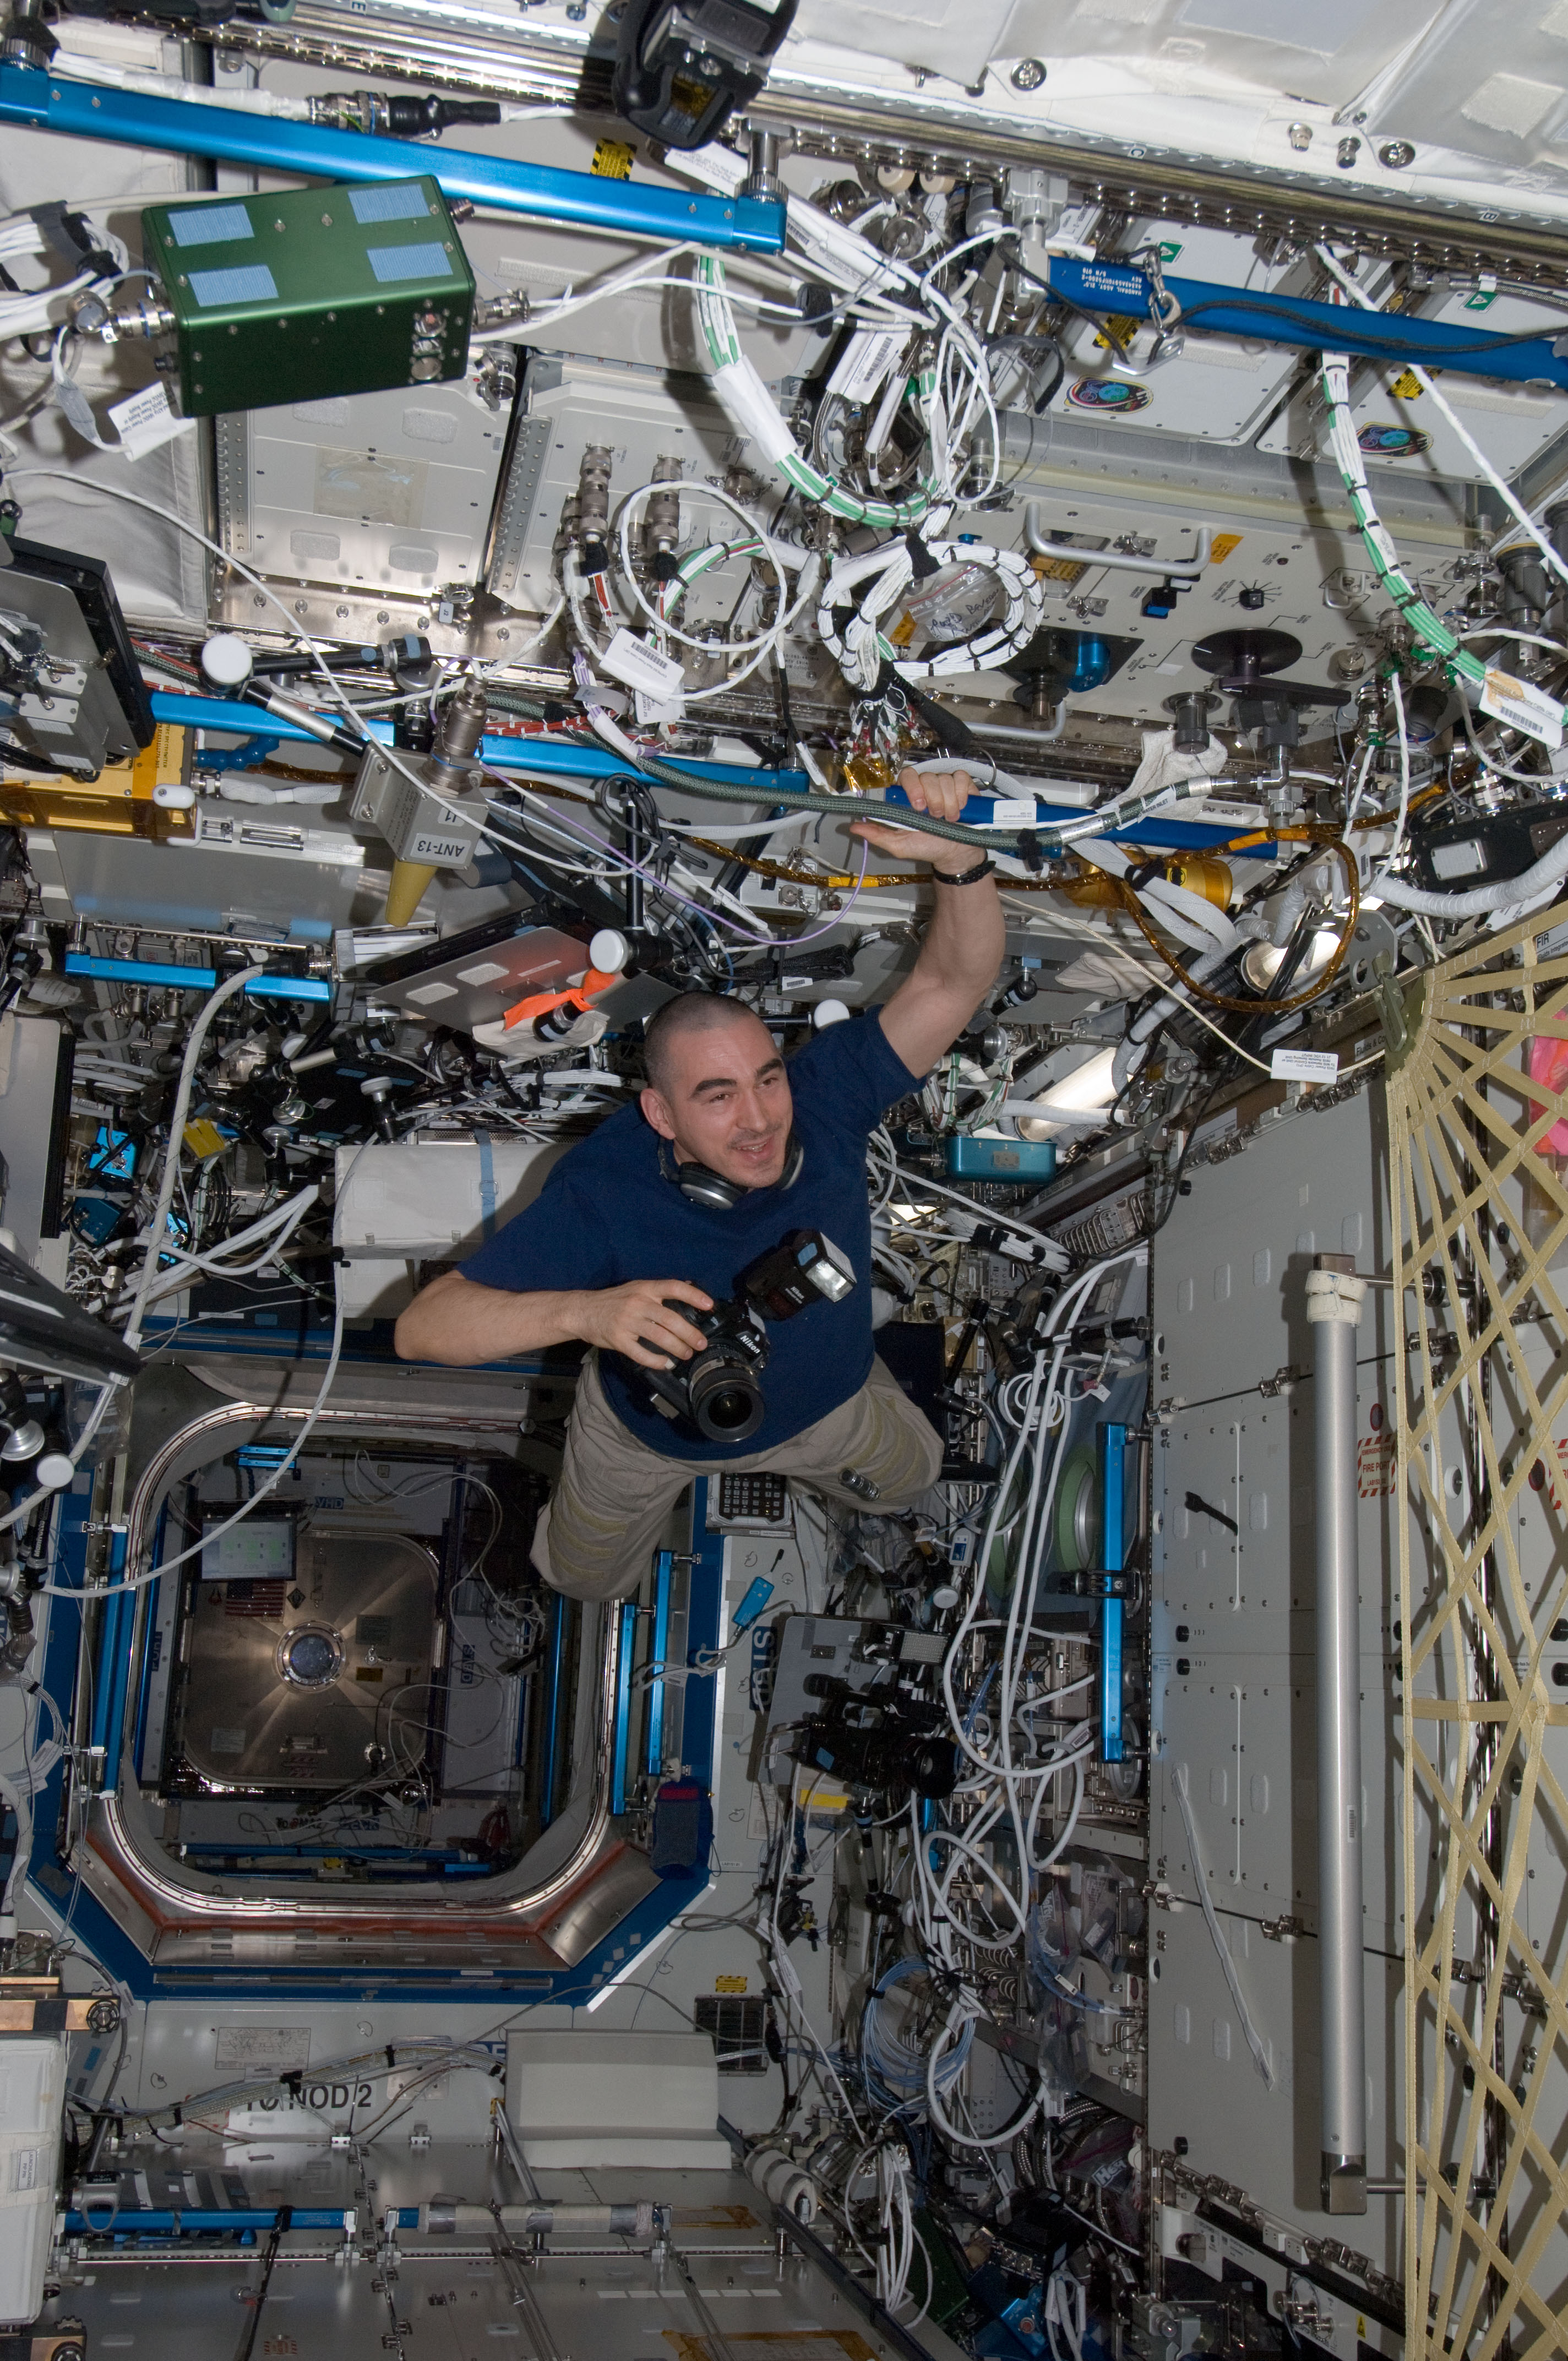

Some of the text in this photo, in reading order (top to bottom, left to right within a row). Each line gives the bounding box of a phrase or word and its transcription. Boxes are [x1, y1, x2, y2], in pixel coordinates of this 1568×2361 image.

[1131, 147, 1146, 159] C
[1483, 211, 1497, 221] B
[416, 841, 466, 857] ANT-13
[1537, 933, 1549, 948] FIR
[1357, 1040, 1371, 1057] Fluids
[791, 1286, 805, 1299] Nikon
[739, 1334, 761, 1354] Nikon
[1363, 1461, 1390, 1473] FIRE PORT
[34, 1520, 45, 1557] Manfrotto
[289, 2085, 349, 2110] NOD
[357, 2083, 372, 2108] 2
